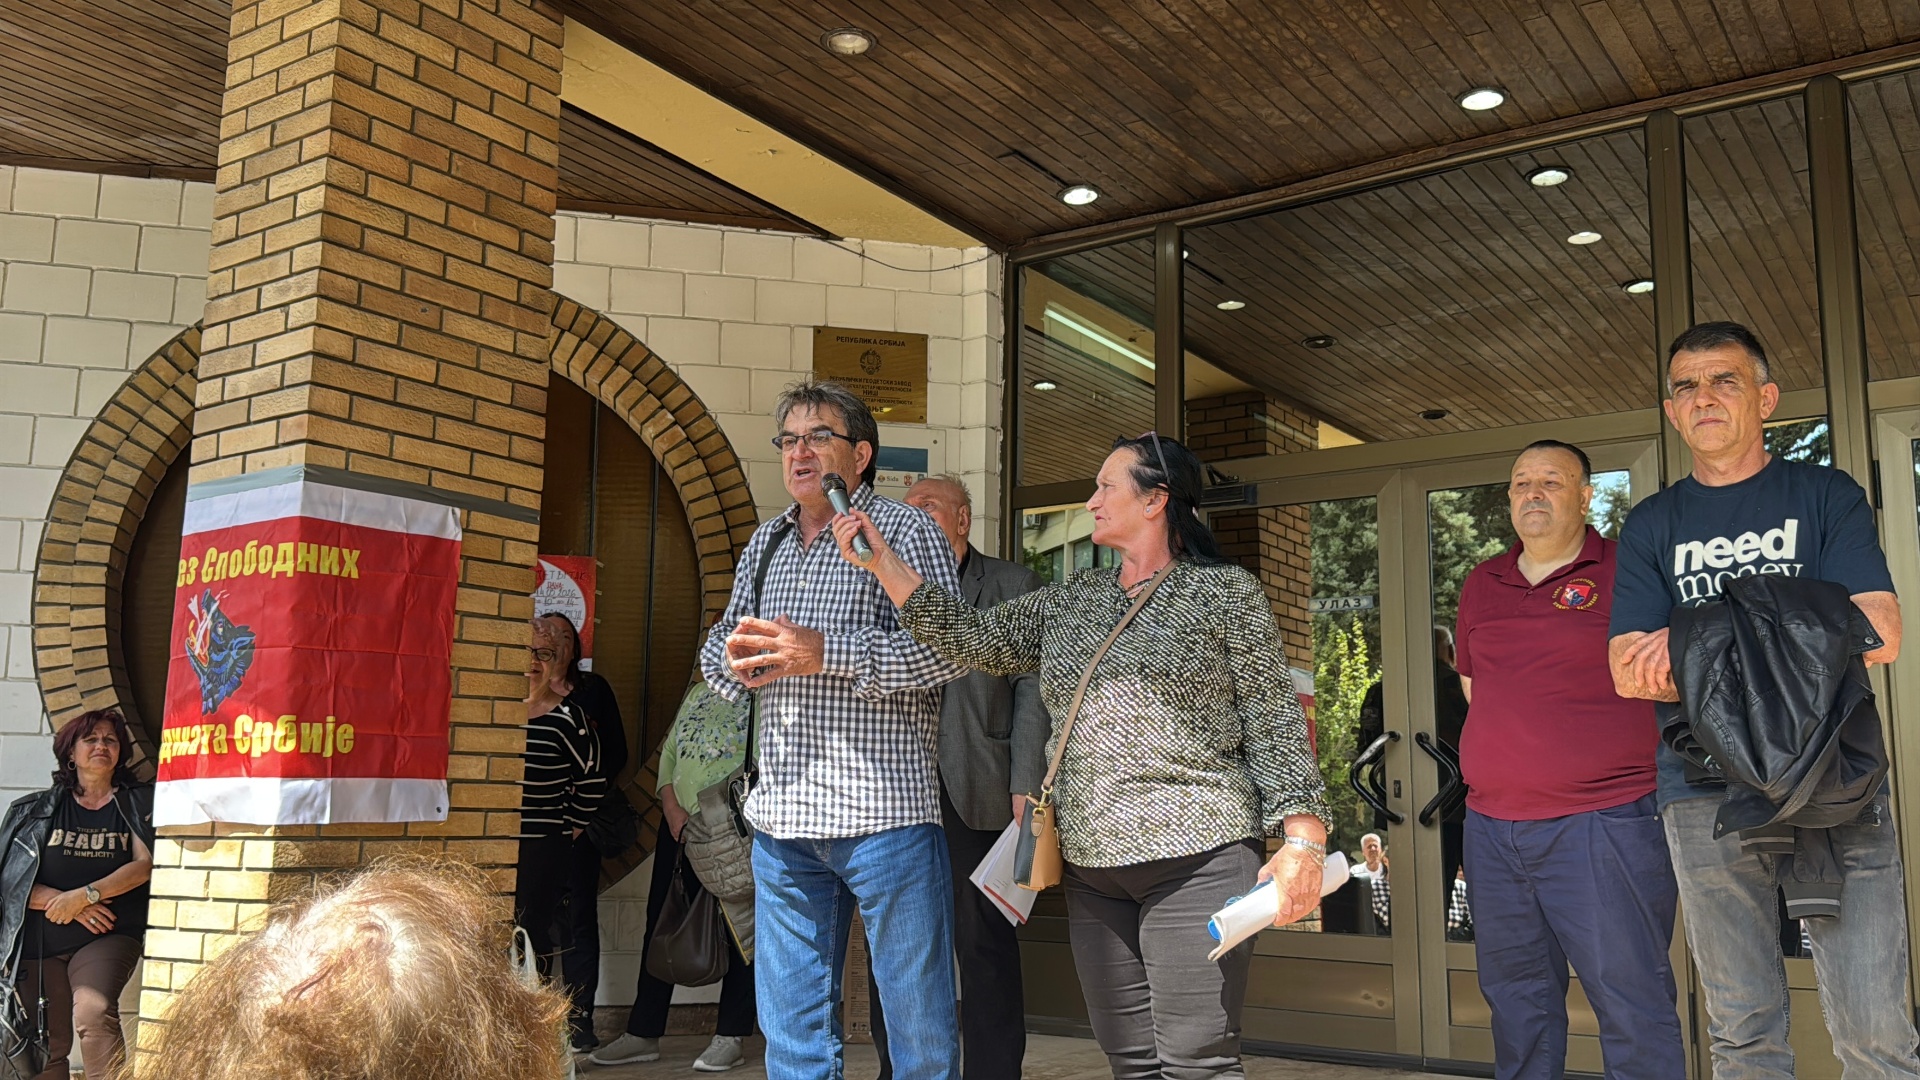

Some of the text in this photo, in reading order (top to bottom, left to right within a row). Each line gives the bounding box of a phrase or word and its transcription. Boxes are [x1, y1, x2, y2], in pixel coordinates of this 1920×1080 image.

[836, 336, 905, 347] РЕПУБЛИКА СРБИЈА
[177, 540, 361, 587] ез Слободних
[1674, 518, 1798, 576] need
[1319, 598, 1361, 609] УЛАЗ
[158, 714, 355, 765] диката Србије
[47, 828, 129, 851] BEAUTY
